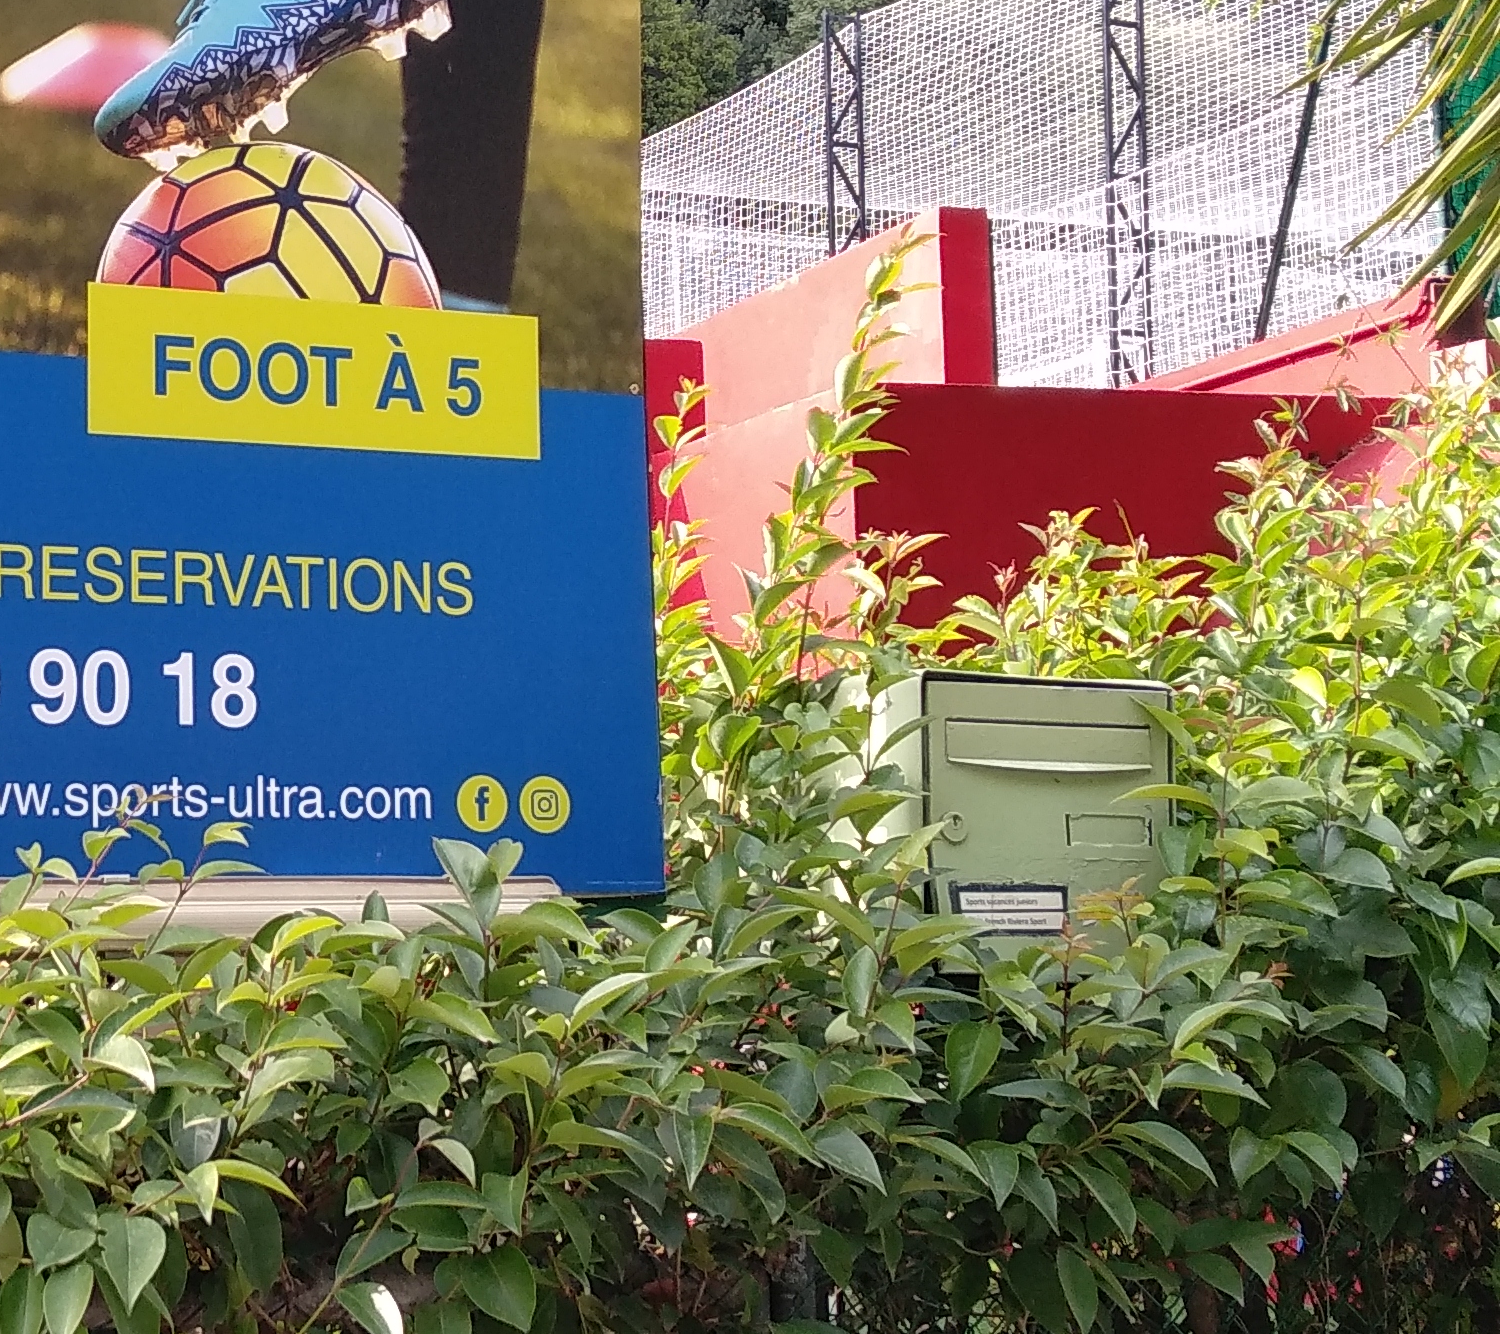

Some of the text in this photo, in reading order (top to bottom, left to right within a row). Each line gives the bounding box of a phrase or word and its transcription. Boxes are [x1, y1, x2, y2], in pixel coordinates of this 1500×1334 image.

[153, 333, 482, 417] FOOT À 5
[28, 648, 131, 726] 90
[162, 651, 258, 729] 18
[965, 897, 987, 906] Sports
[987, 898, 1015, 906] vacances
[1007, 917, 1029, 925] Riviera
[1030, 917, 1047, 926] Sport
